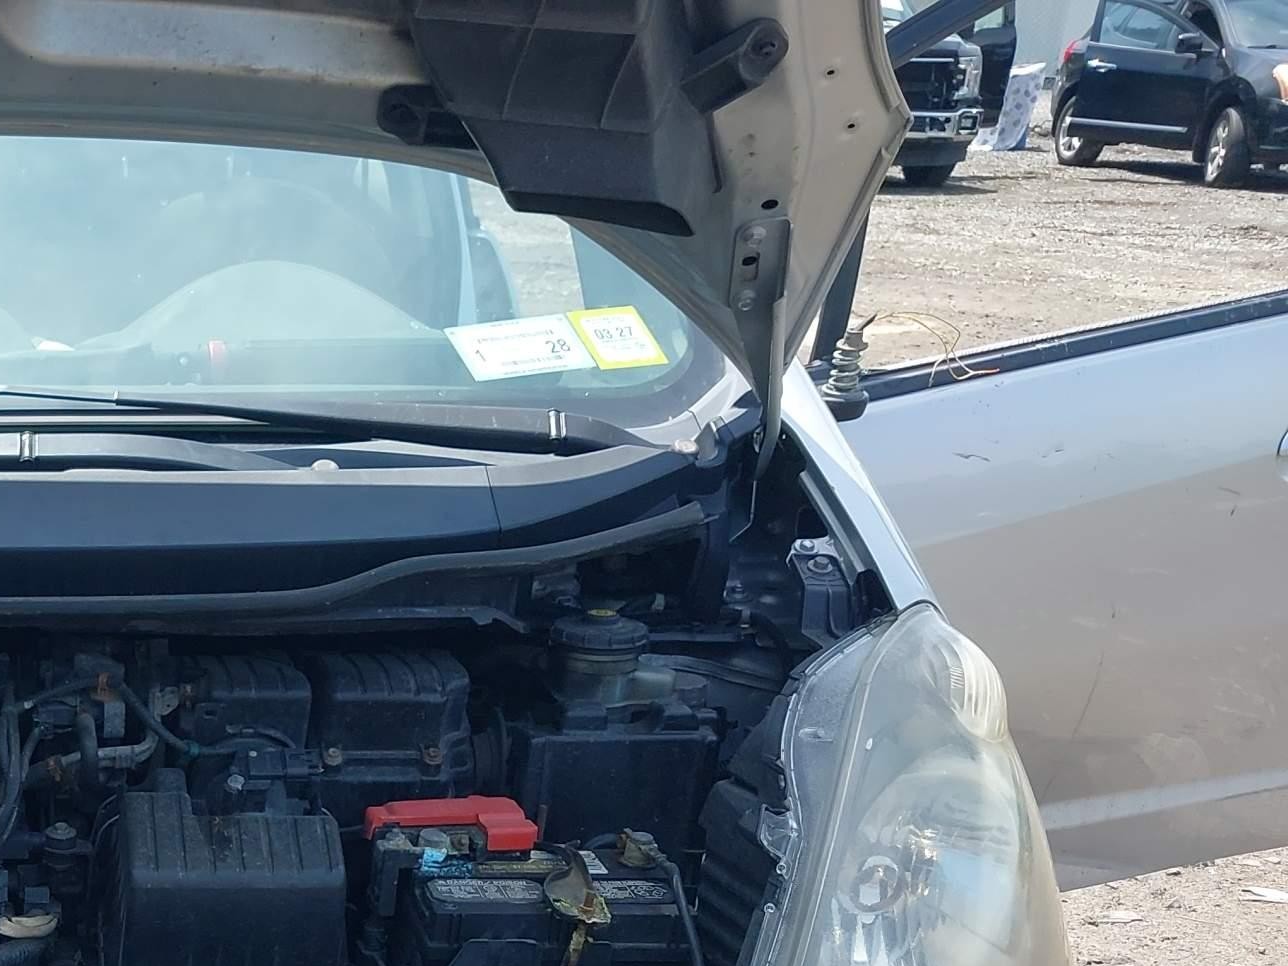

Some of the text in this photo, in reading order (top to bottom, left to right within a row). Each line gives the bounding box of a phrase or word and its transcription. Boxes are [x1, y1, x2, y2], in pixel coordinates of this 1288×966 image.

[593, 325, 634, 340] 03 27
[545, 338, 571, 354] 28
